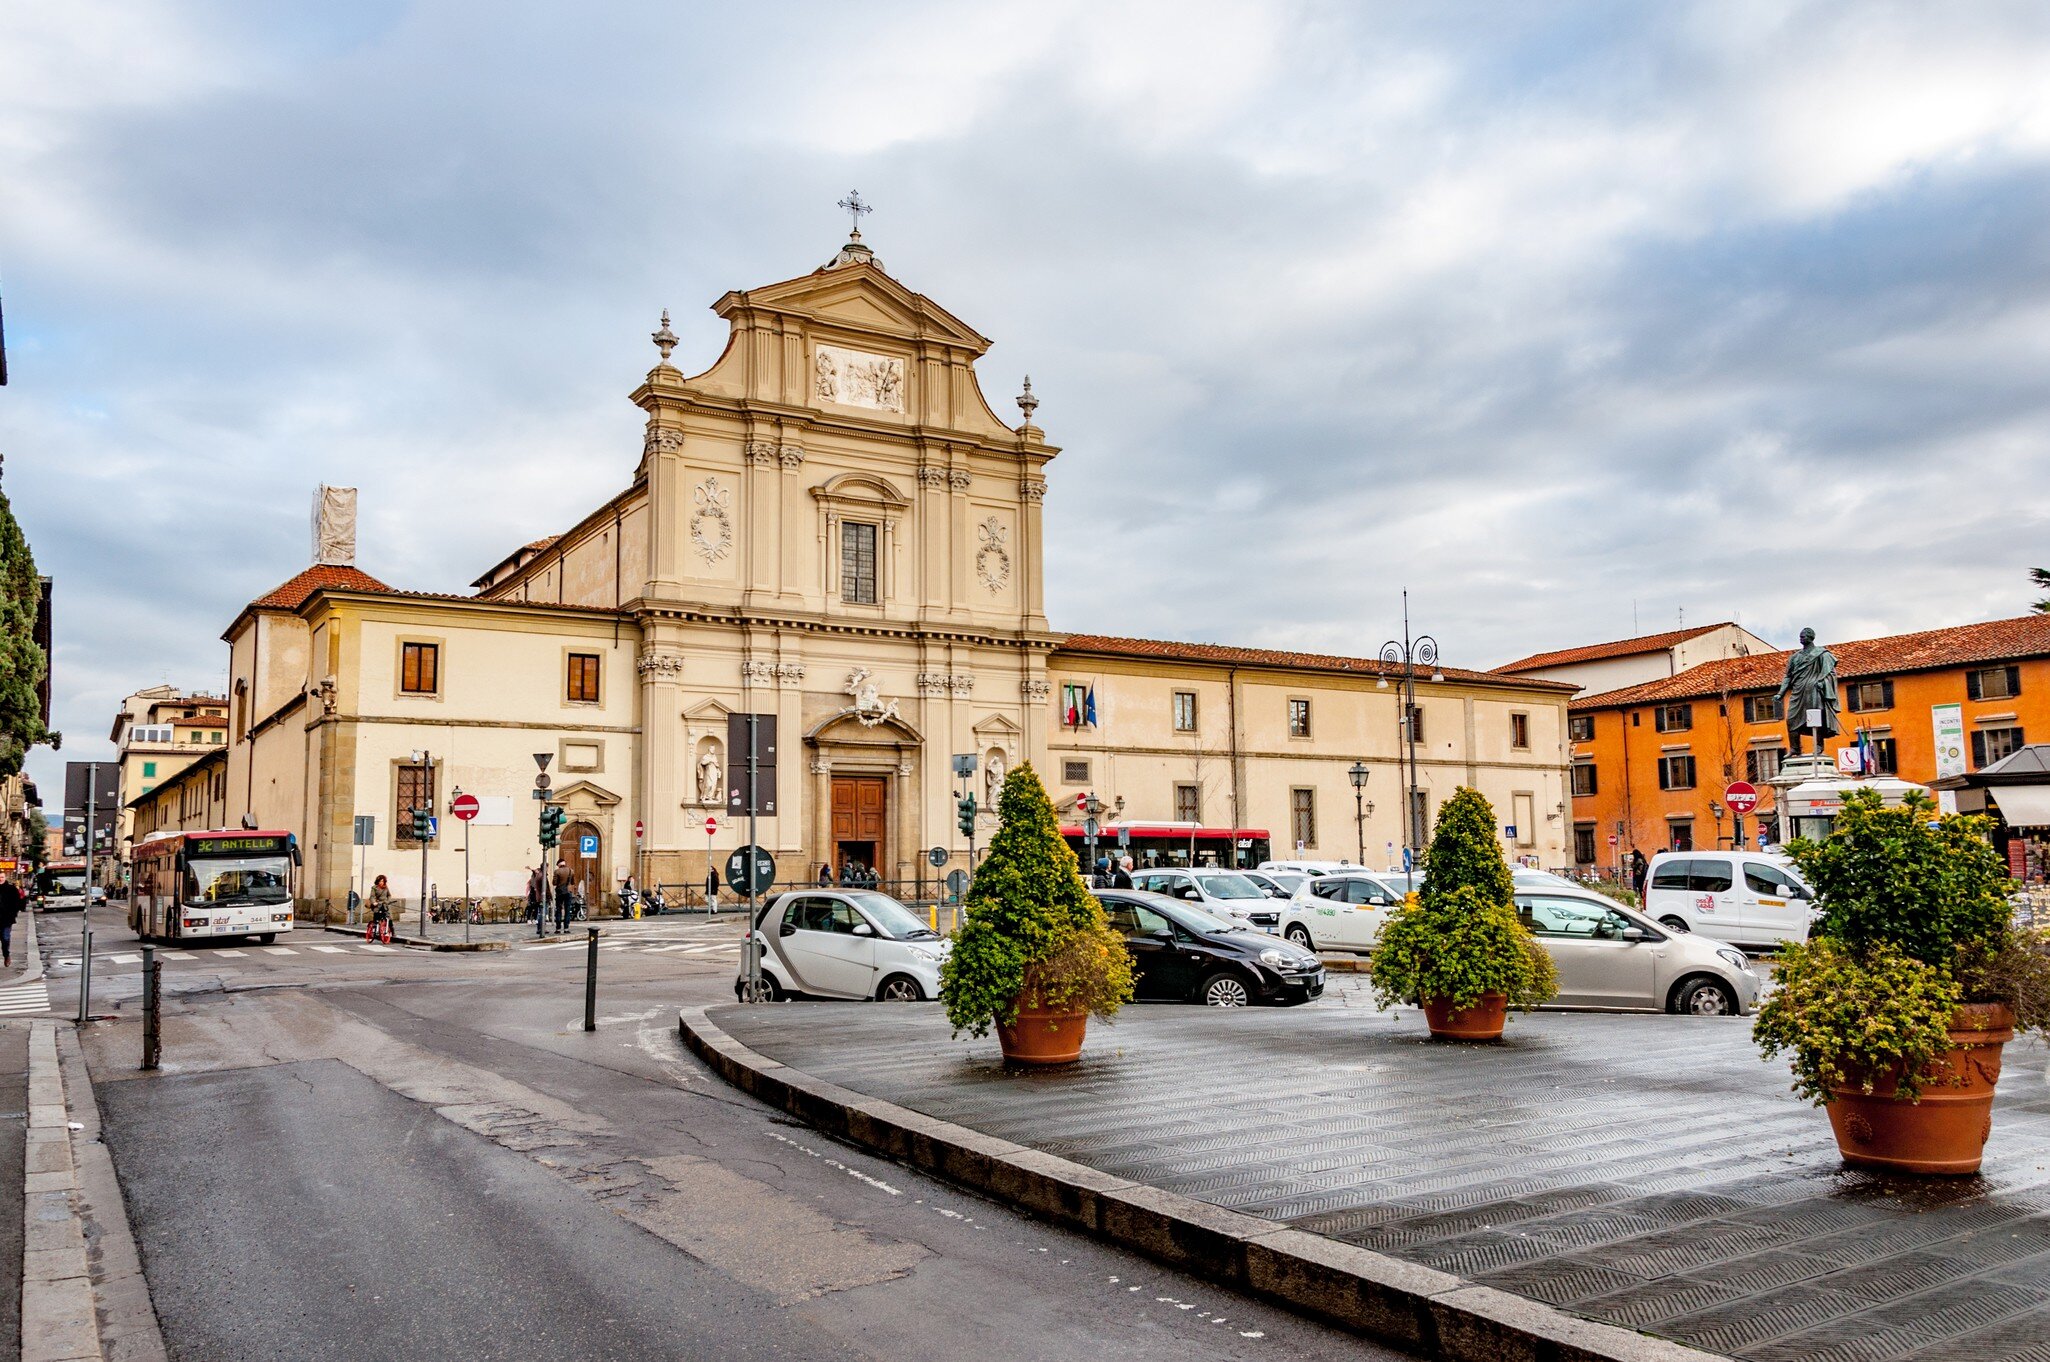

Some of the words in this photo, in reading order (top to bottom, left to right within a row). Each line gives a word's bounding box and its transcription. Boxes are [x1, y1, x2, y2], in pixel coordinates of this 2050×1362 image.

[198, 840, 213, 853] 32
[222, 839, 274, 849] ANTELLA
[584, 838, 595, 851] P
[1238, 838, 1253, 848] ataf
[212, 915, 231, 925] ataf
